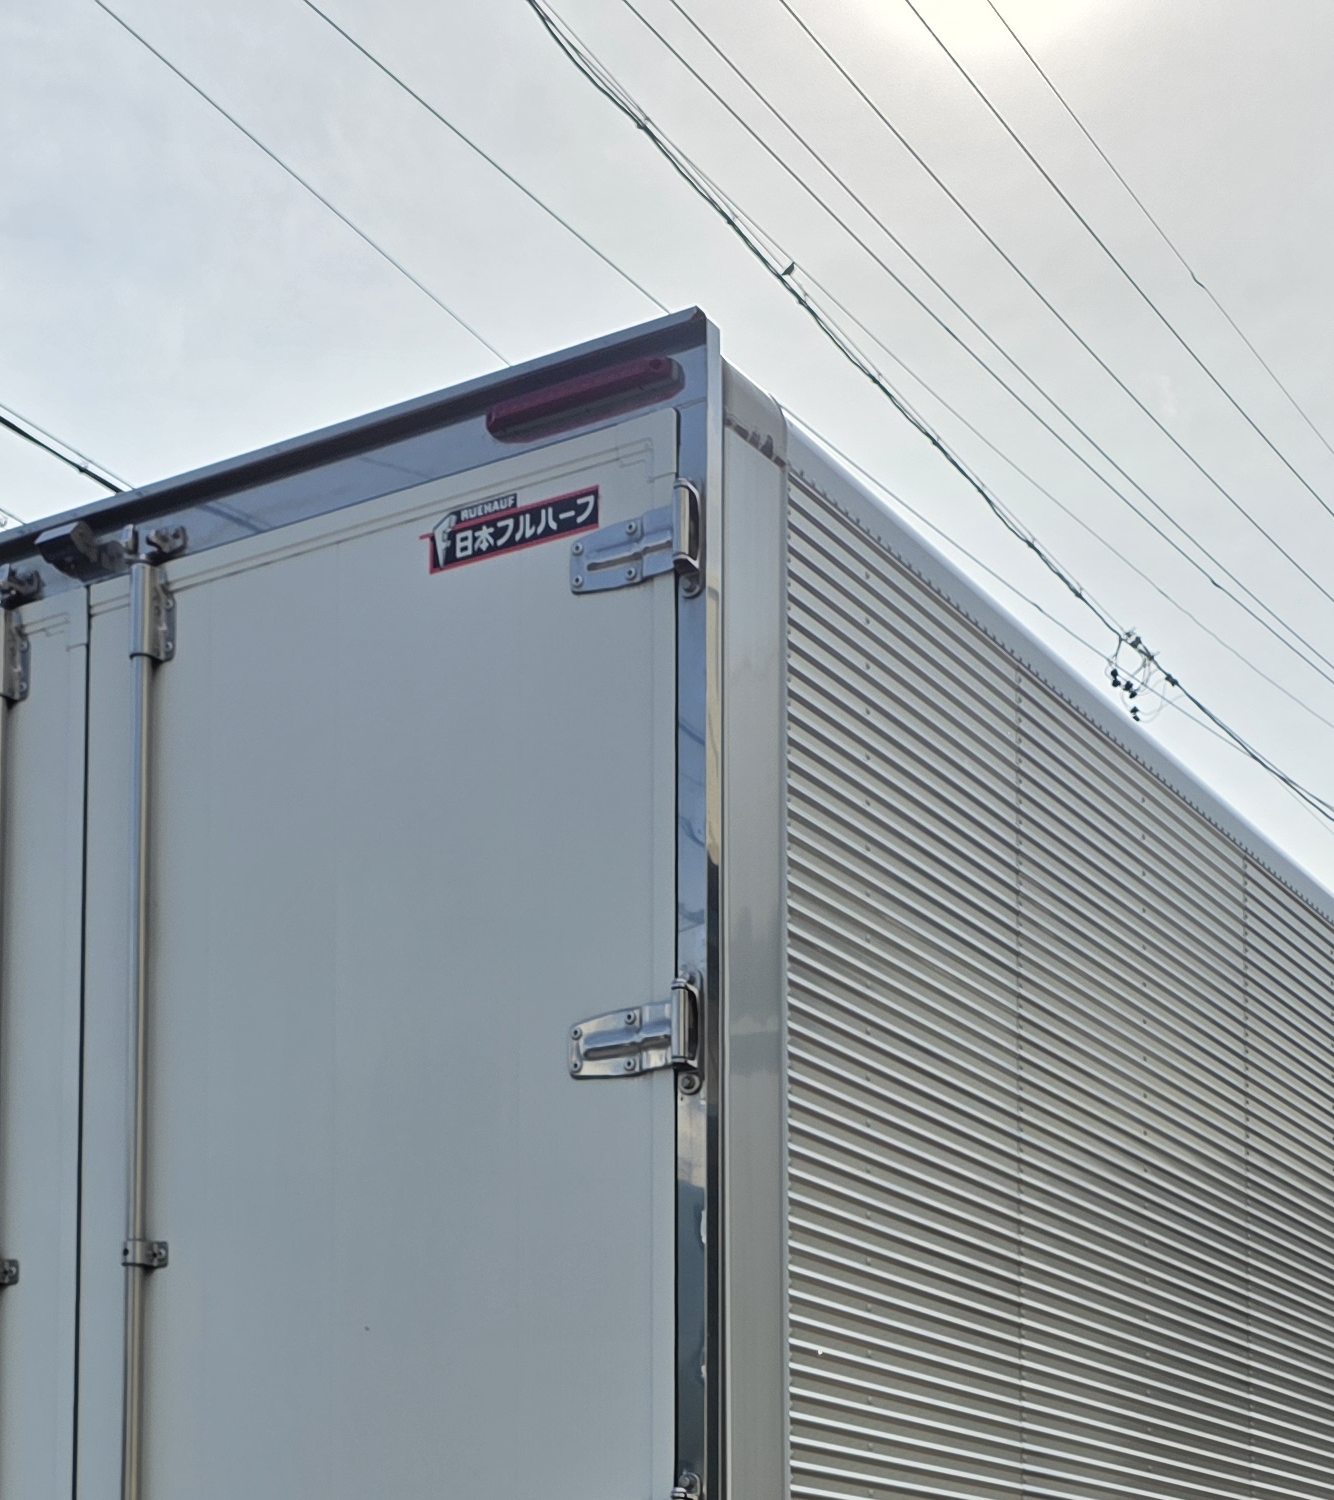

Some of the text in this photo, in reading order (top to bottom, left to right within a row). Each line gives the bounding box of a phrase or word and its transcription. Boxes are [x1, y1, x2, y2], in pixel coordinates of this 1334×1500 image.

[455, 494, 596, 559] 日本フルハーフ
